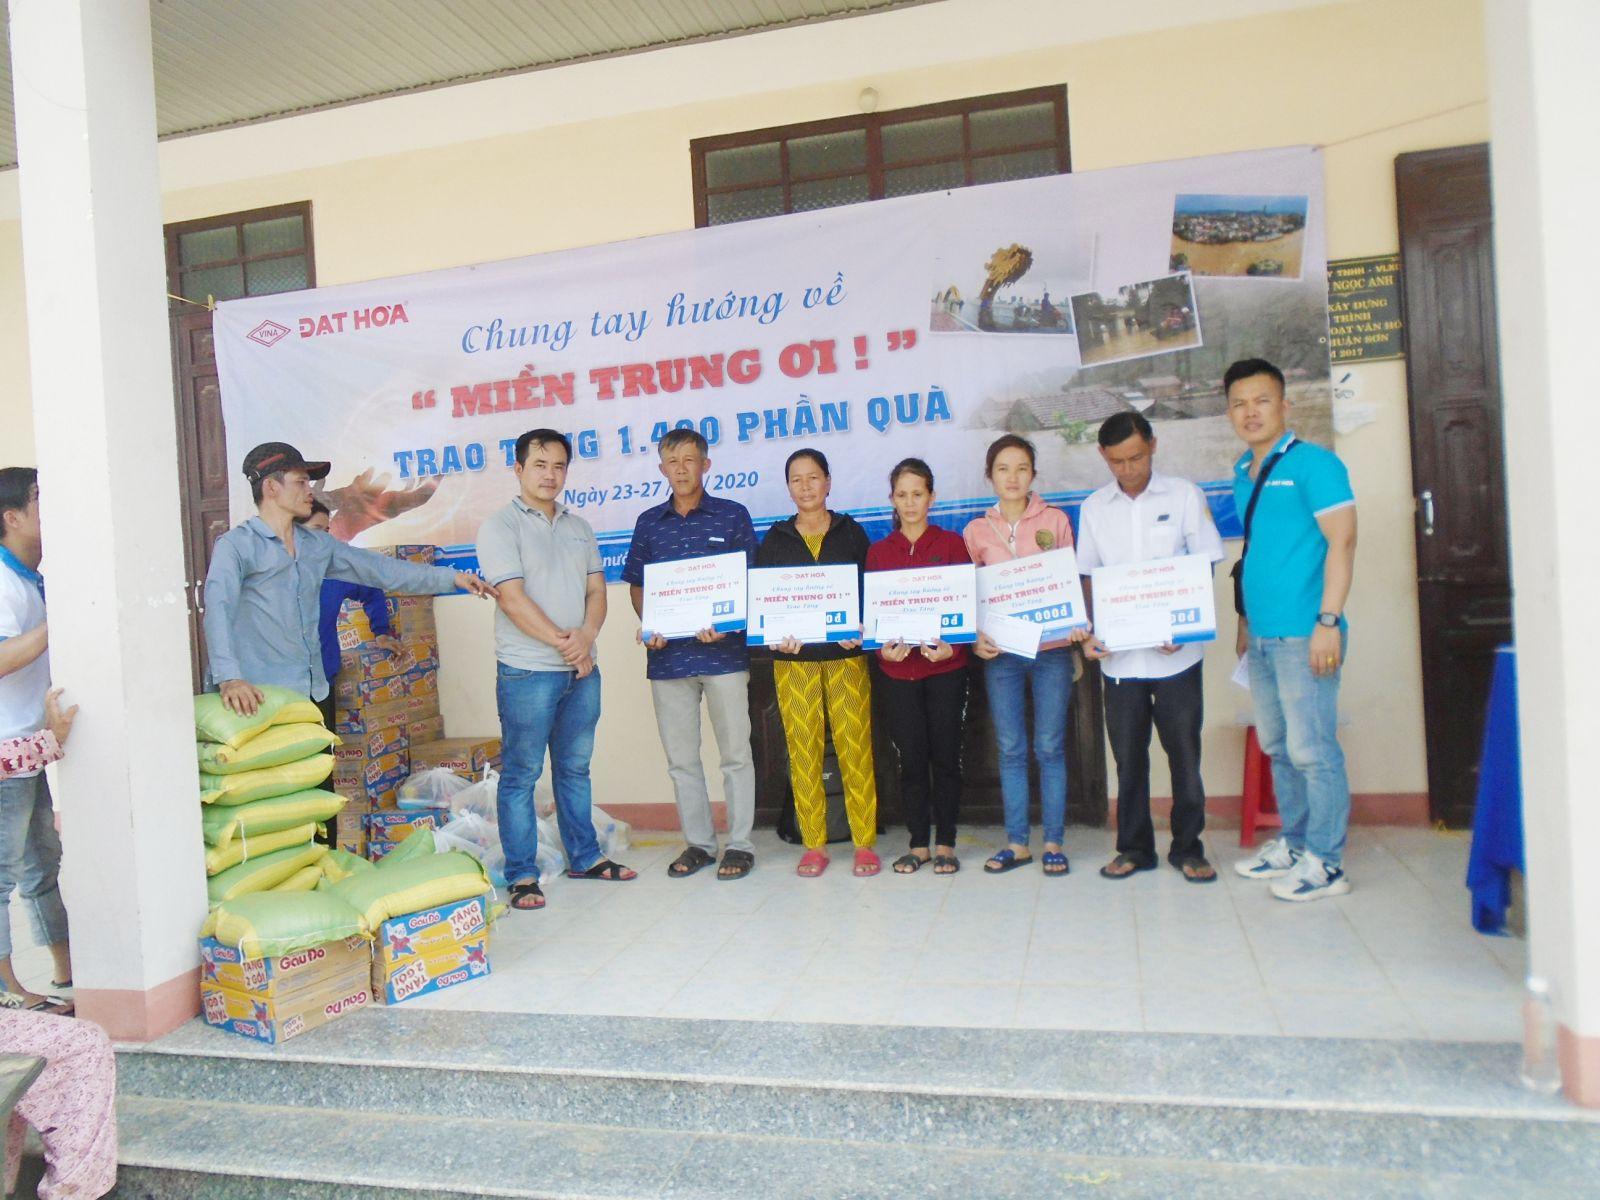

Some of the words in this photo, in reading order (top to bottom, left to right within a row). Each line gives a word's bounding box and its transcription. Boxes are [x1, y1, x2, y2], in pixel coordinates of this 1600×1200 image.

[298, 311, 348, 338] ĐẠT
[353, 303, 409, 331] HÒA
[461, 318, 576, 354] Chung
[591, 309, 652, 342] tay
[666, 290, 788, 327] hướng
[802, 271, 847, 309] về
[259, 329, 279, 339] VINA
[1340, 348, 1363, 358] 2017
[450, 363, 576, 418] MIỀN
[589, 348, 762, 399] TRUNG
[778, 339, 838, 379] ƠI
[393, 442, 486, 479] TRAO
[498, 429, 600, 467] TG
[736, 394, 850, 443] PHẦN
[867, 385, 952, 433] QUÀ
[564, 486, 608, 508] Ngày
[612, 481, 662, 501] 23-27
[713, 470, 759, 491] 2020
